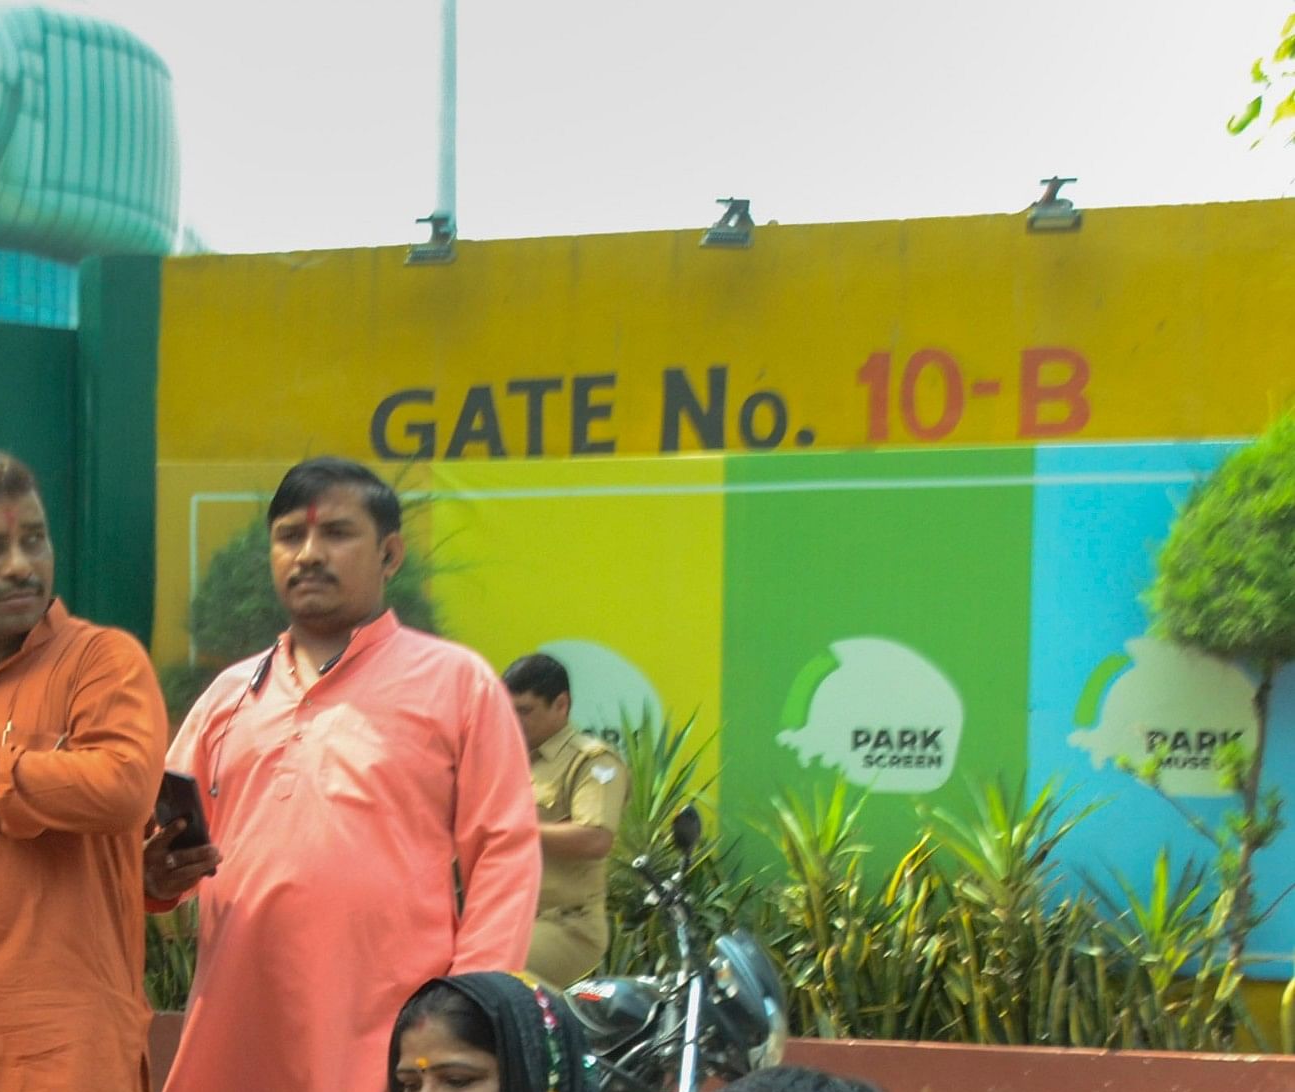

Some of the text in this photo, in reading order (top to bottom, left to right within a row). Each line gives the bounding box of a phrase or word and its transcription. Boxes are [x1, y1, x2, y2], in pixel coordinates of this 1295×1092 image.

[369, 346, 1093, 463] GATE No. 10-B
[851, 729, 943, 752] PARK
[862, 754, 943, 769] SCREEN
